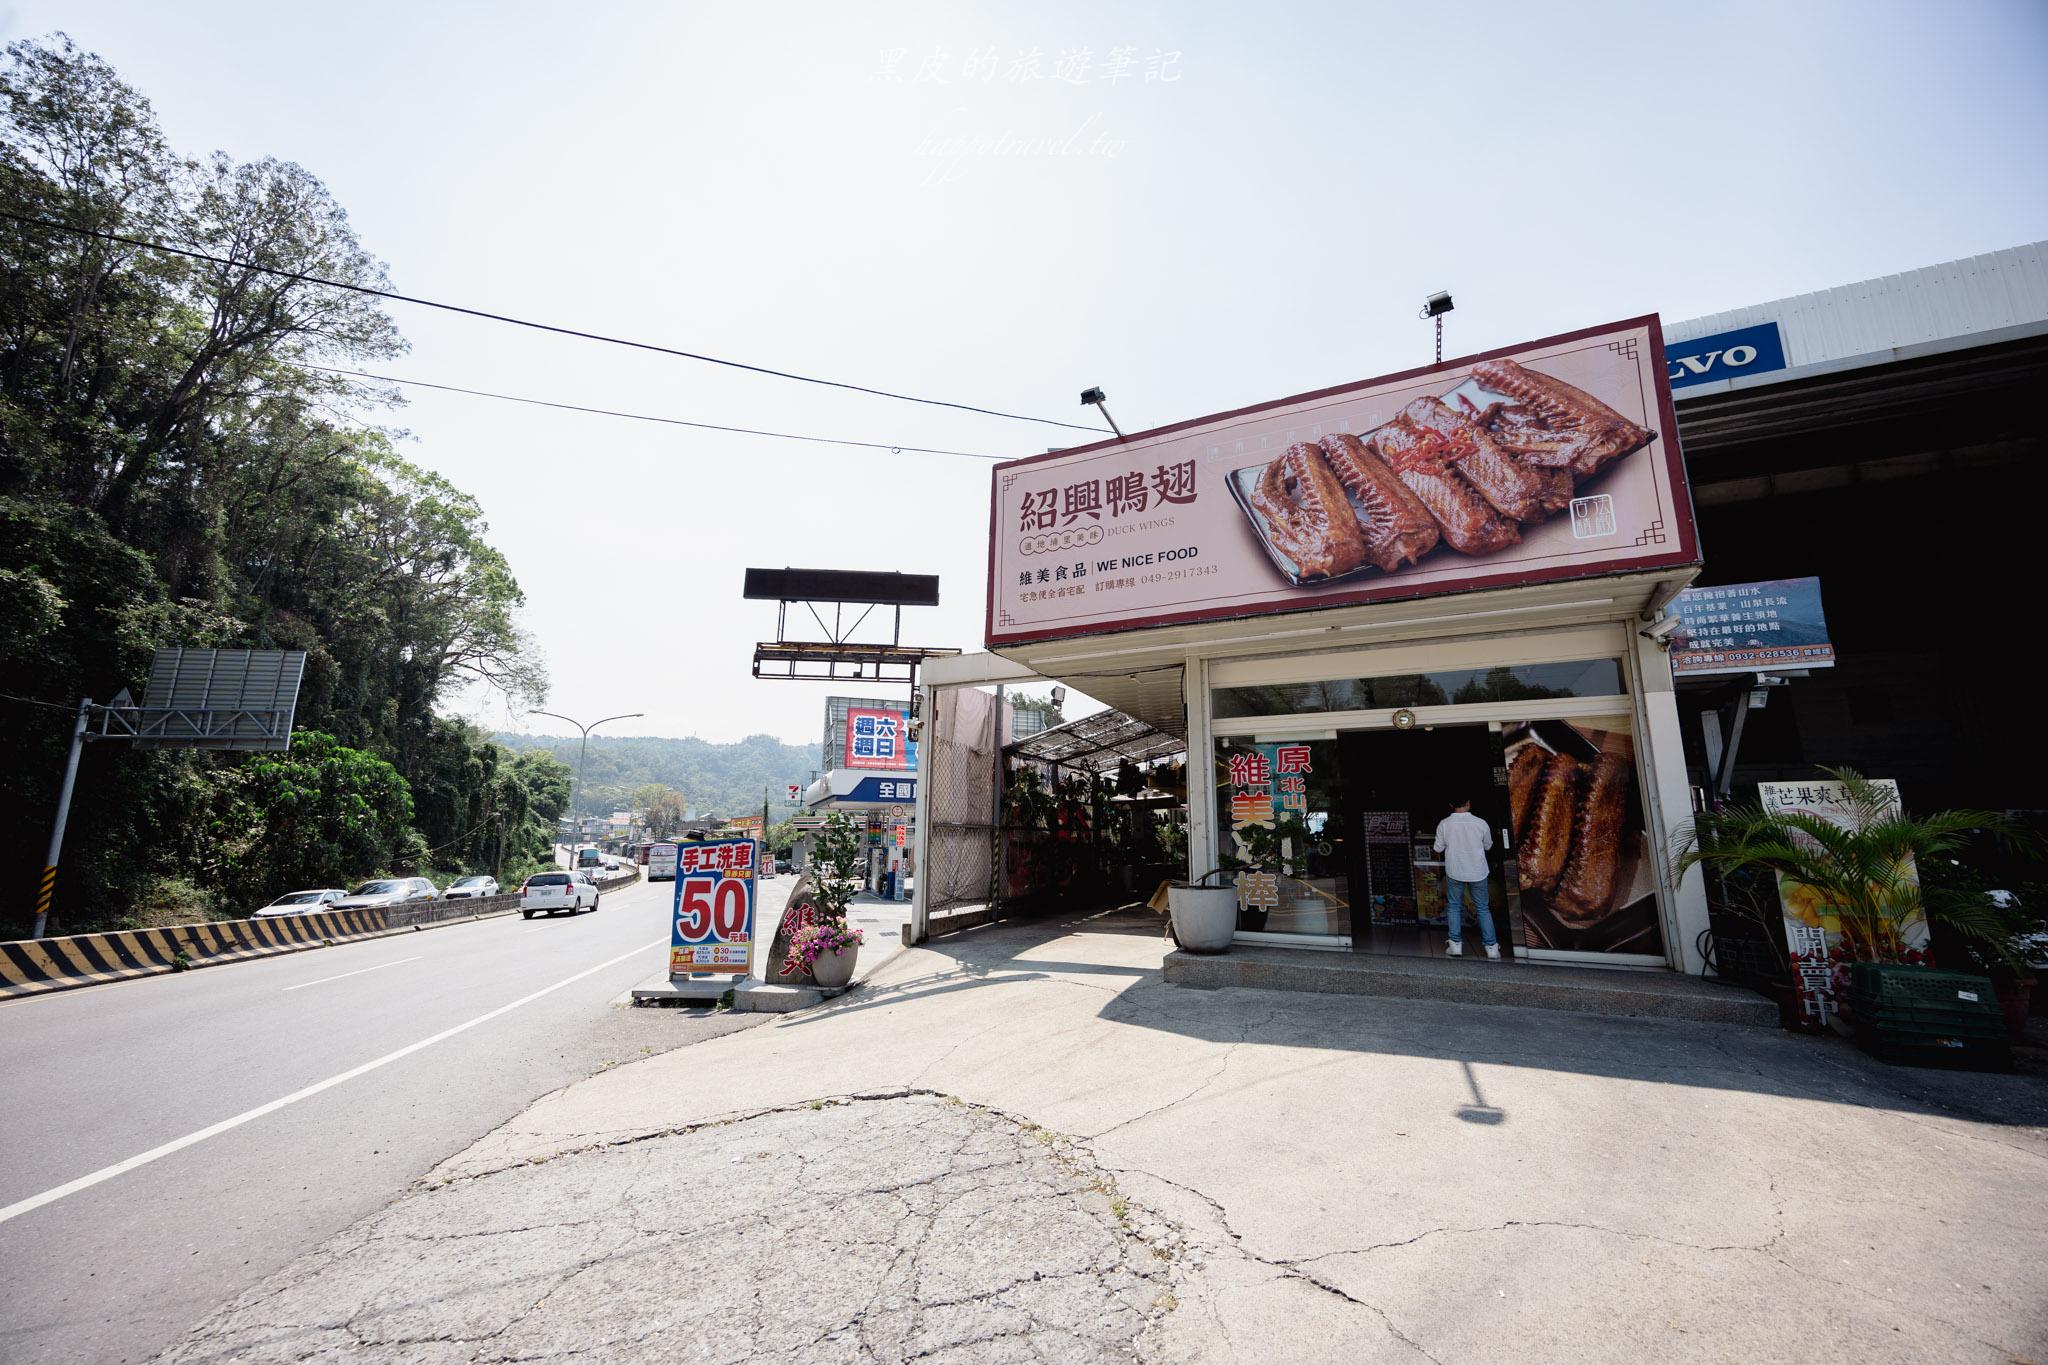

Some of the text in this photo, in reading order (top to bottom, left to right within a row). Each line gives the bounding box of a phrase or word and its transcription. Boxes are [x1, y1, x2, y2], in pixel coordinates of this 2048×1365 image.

[1020, 459, 1198, 532] 紹興鴨翅
[1107, 517, 1175, 537] DUCK WINGS
[1097, 546, 1198, 573] WE NICE FOOD
[1019, 562, 1087, 586] 維美食品
[1095, 564, 1218, 592] 訂購專線 049-2917343
[1019, 584, 1086, 603] 宅急便全省宅配
[1687, 622, 1780, 637] 堅持在最好的地點
[1689, 638, 1735, 649] 成就完美
[1681, 653, 1725, 665] 洽詢專線
[1728, 649, 1800, 661] 0932-628536
[855, 716, 897, 737] 週六
[853, 737, 896, 758] 週日
[879, 782, 917, 799] 全國
[682, 845, 752, 873] 手工洗車
[679, 879, 746, 939] 50
[729, 932, 748, 942] 元起
[1791, 926, 1840, 1027] 開賣中
